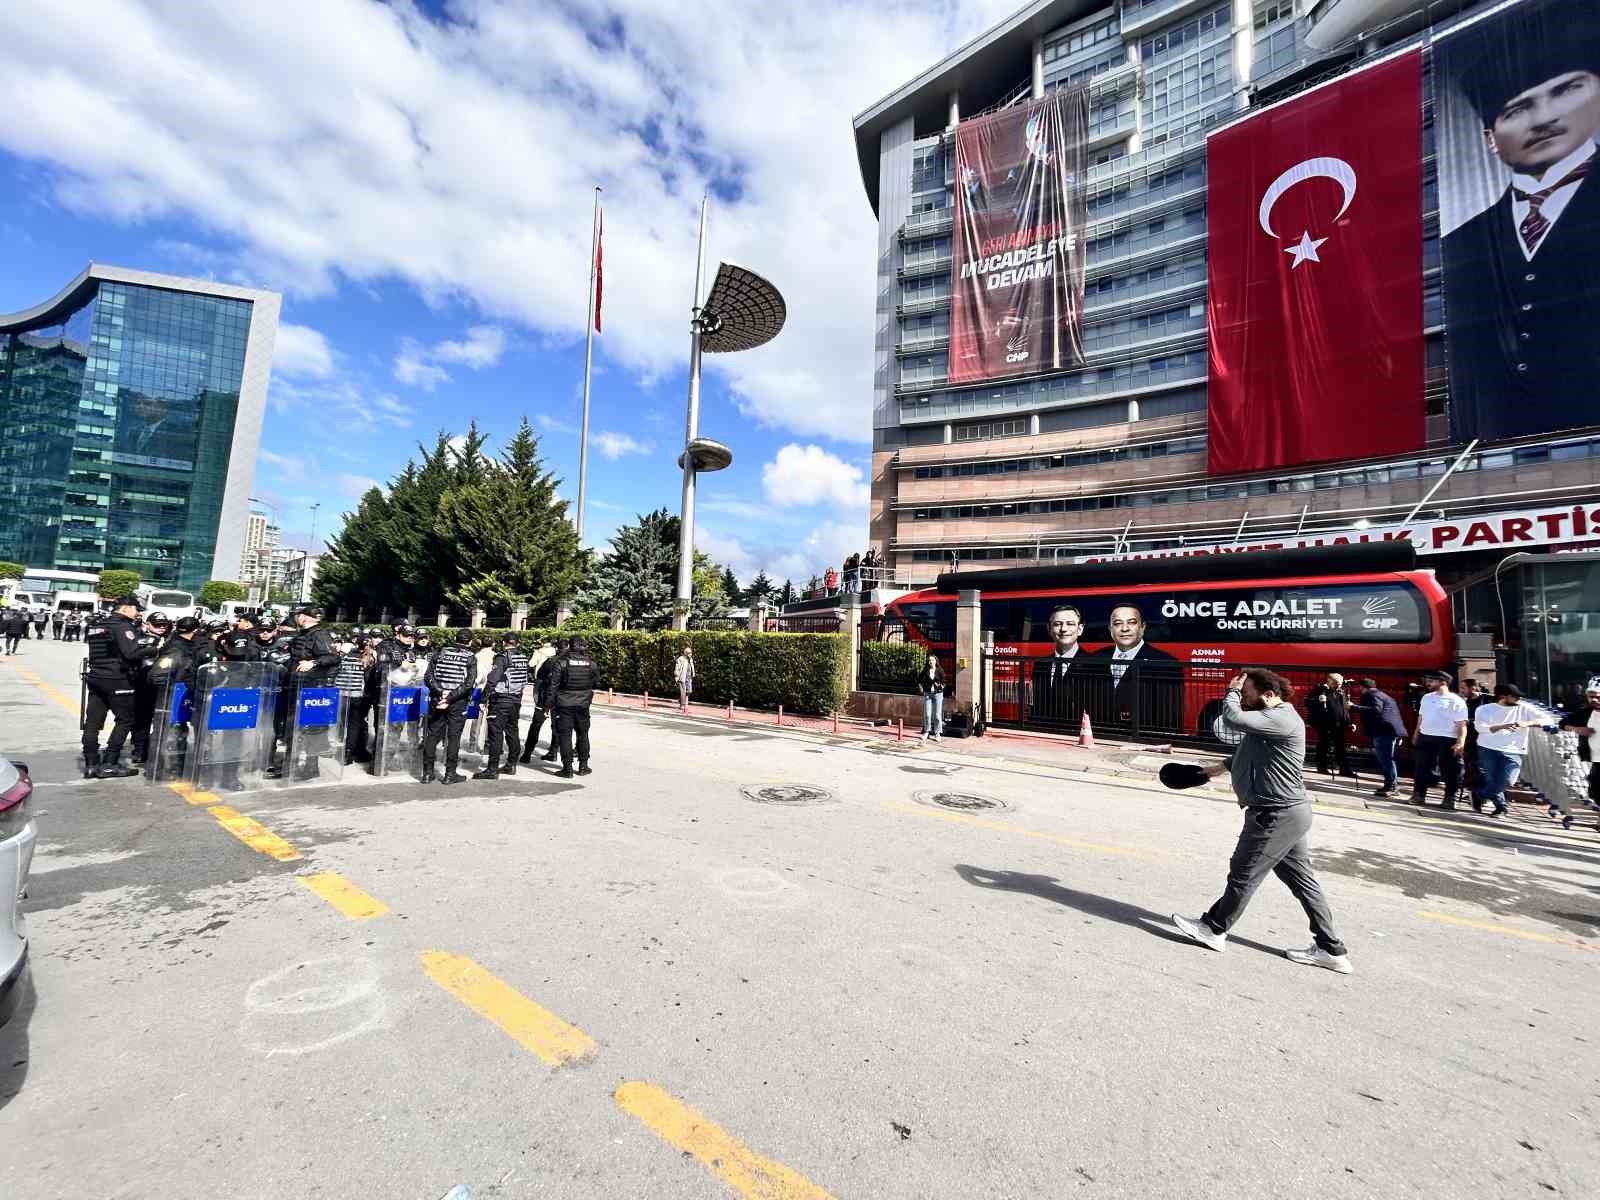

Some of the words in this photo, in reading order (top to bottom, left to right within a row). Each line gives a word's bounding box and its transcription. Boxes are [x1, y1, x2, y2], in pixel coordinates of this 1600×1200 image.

[987, 260, 1053, 291] DEVAM
[1161, 599, 1228, 618] ÖNCE
[1234, 598, 1343, 617] ADALET
[1216, 618, 1257, 630] ÖNCE
[1260, 616, 1343, 630] HÜRRİYET!
[1362, 618, 1399, 629] CHP
[219, 703, 249, 713] POLİS
[304, 697, 331, 707] POLİS
